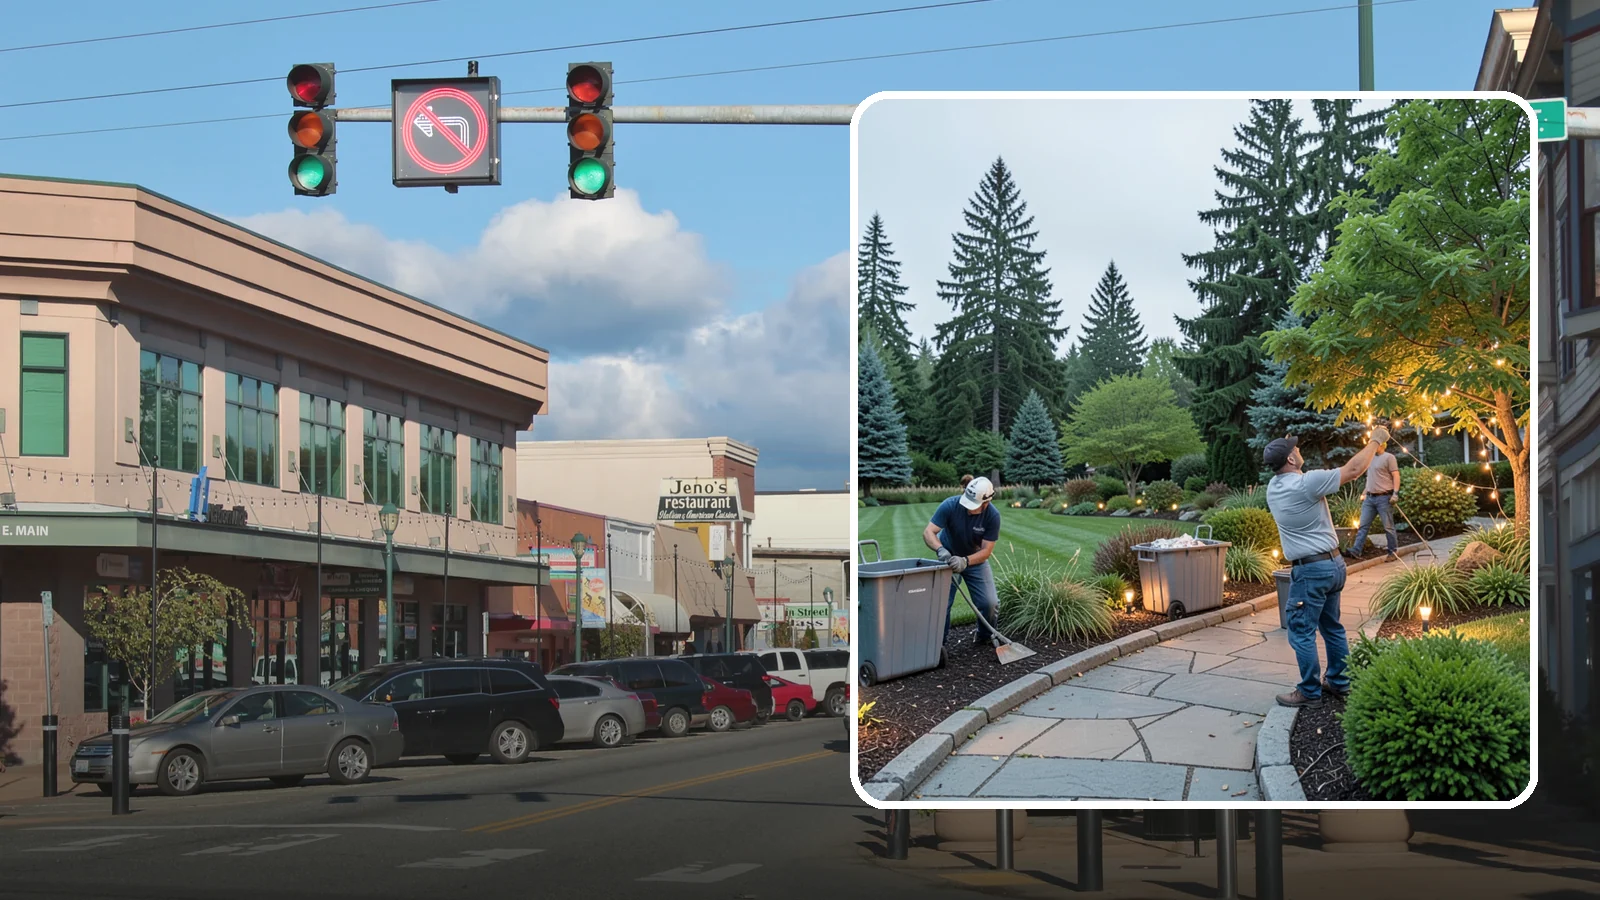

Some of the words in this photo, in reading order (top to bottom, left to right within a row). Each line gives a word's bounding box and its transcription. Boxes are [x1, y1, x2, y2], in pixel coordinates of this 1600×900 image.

[670, 480, 727, 494] Jeno's
[665, 496, 731, 509] restaurant
[658, 510, 681, 519] Italian
[686, 510, 714, 519] American
[715, 510, 737, 519] Cuisine
[2, 525, 13, 536] E.
[15, 525, 49, 536] MAIN
[797, 607, 828, 616] Street
